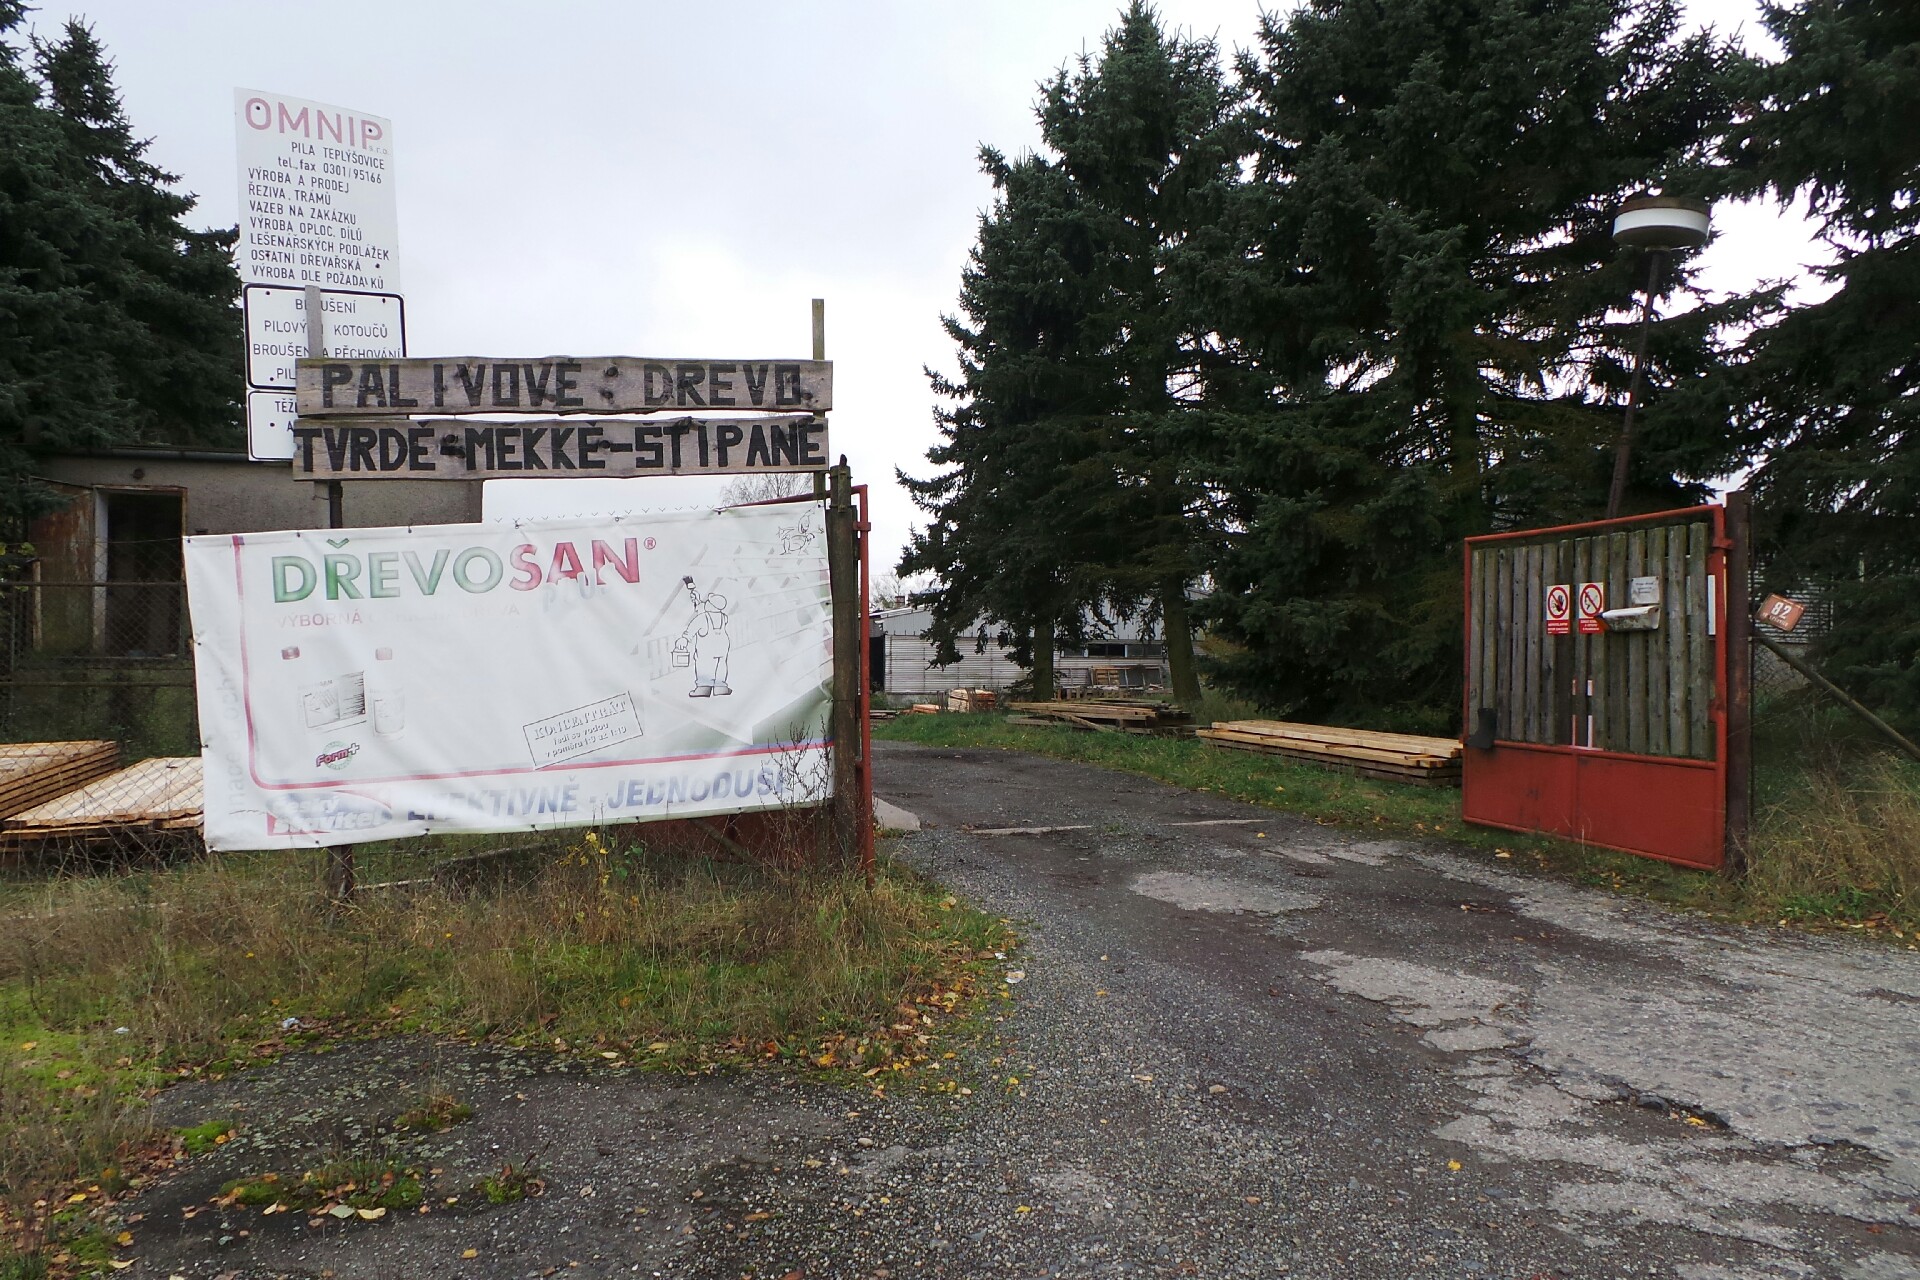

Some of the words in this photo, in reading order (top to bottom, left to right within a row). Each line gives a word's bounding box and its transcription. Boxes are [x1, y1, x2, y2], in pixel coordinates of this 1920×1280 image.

[245, 97, 383, 149] OMNIP
[291, 141, 315, 156] PILA
[323, 147, 385, 170] TEPLÝŠOVICE
[248, 166, 291, 184] VÝROBA
[298, 175, 305, 186] A
[311, 176, 349, 194] PRODEJ
[323, 162, 382, 184] 0301/95166
[249, 200, 284, 215] VAZEB
[289, 205, 304, 217] NA
[310, 207, 356, 226] ZAKÁZKU
[250, 214, 293, 233] VÝROBA
[250, 231, 334, 253] LEŠENÁŘSKÝCH
[339, 243, 389, 261] PODLÁŽEK
[251, 248, 295, 264] OSTATNÍ
[300, 252, 361, 272] DŘEVAŘSKÁ
[252, 263, 295, 280] VÝROBA
[301, 269, 321, 283] DLE
[295, 297, 356, 314] BUŠENÍ
[264, 319, 323, 335] PILOVÝ
[334, 323, 388, 339] KOTOUČŮ
[253, 342, 311, 357] BROUŠEN
[1770, 601, 1792, 620] 82
